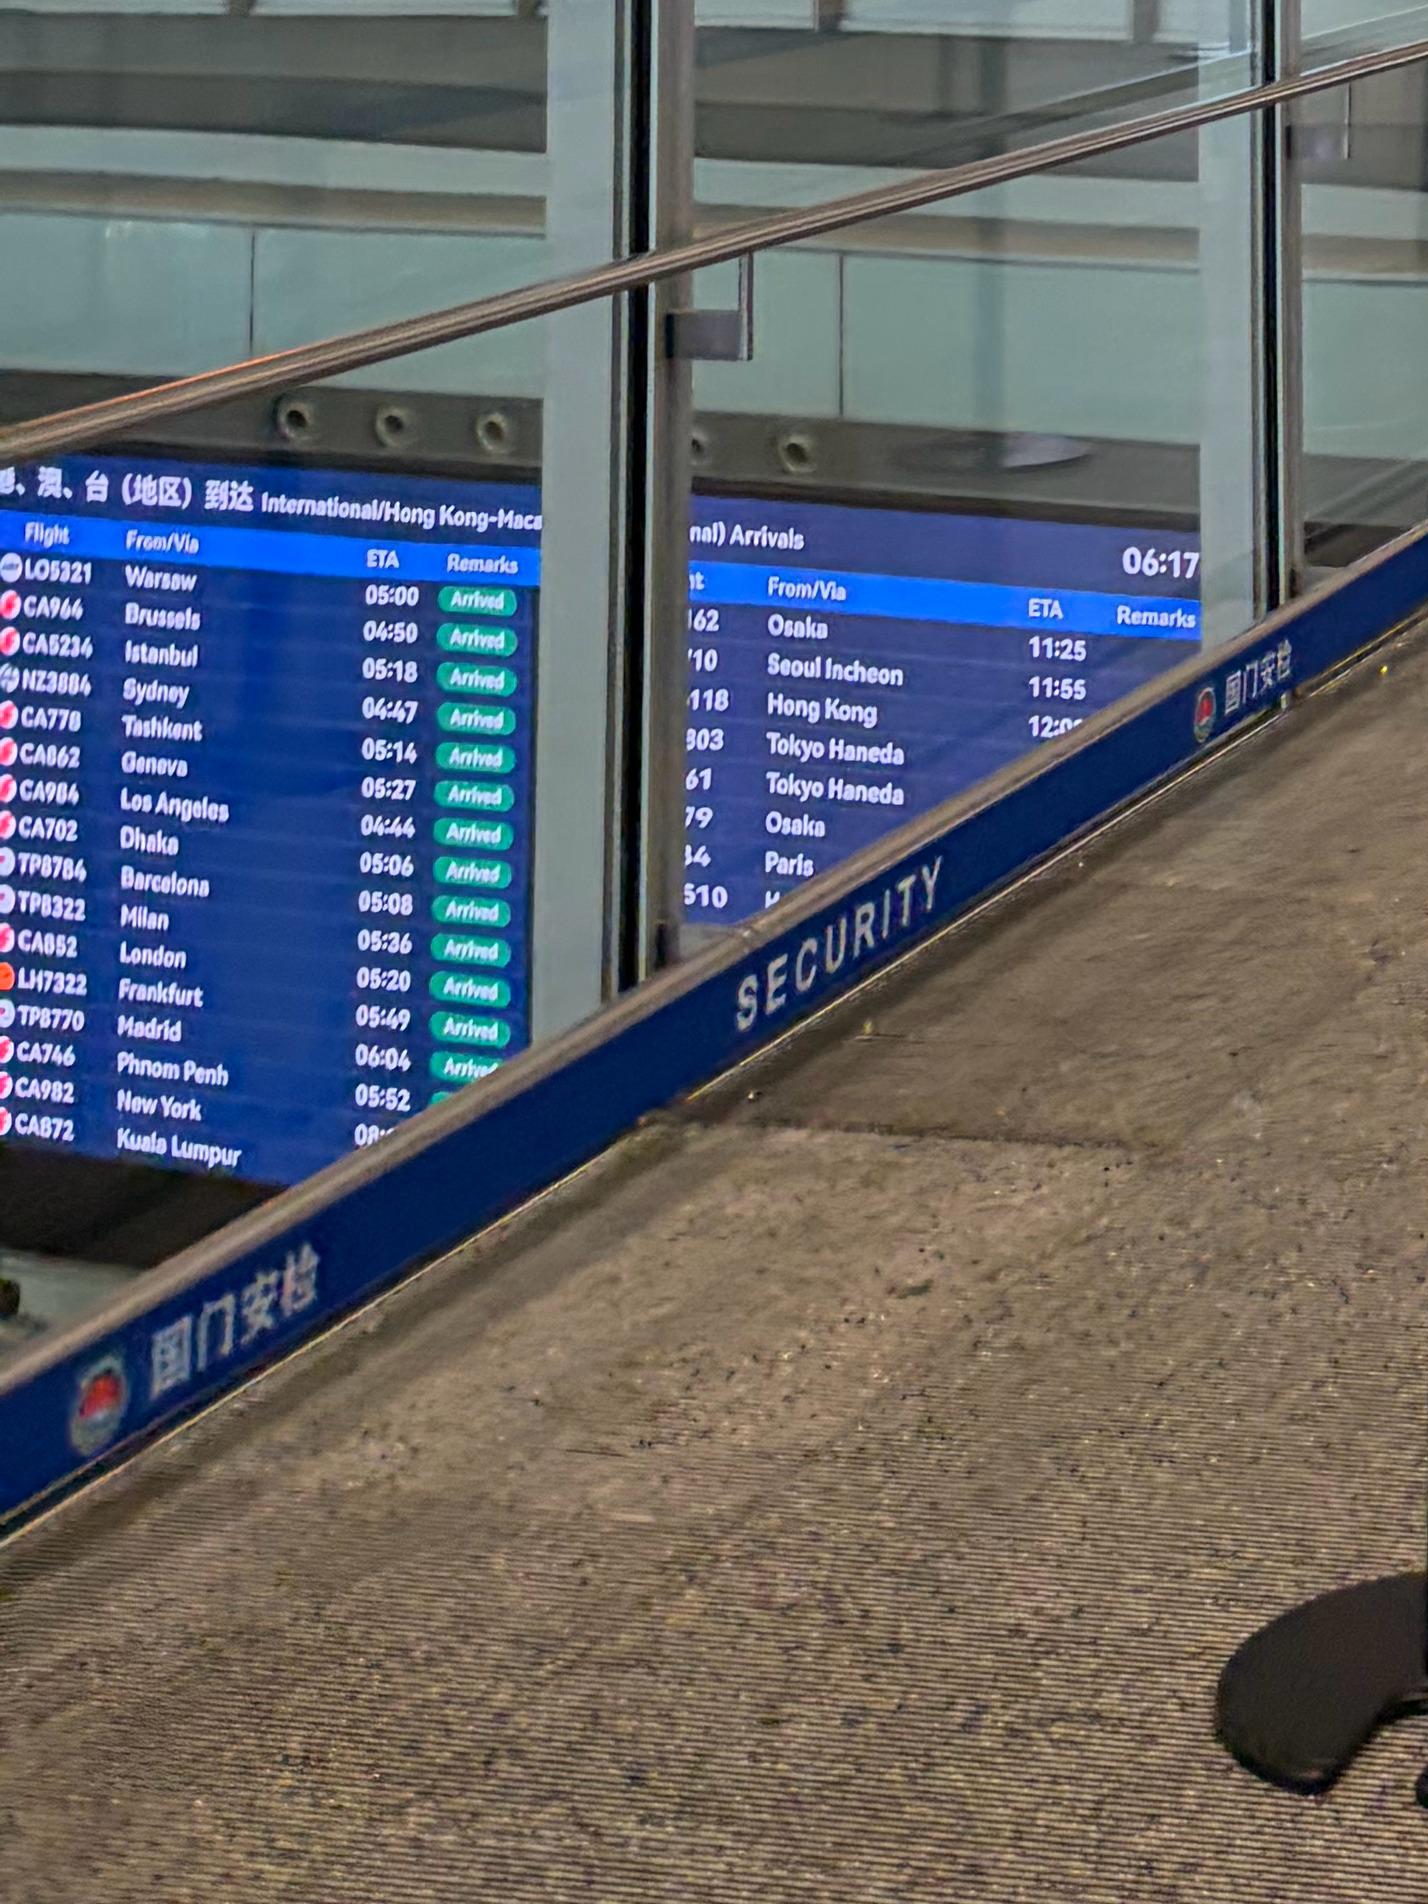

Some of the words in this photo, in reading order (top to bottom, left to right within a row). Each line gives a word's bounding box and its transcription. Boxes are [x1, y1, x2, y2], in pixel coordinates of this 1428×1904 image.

[25, 523, 70, 546] Flight
[127, 531, 198, 552] From/Via
[368, 550, 398, 567] ETA
[448, 554, 517, 573] Remarks
[730, 525, 804, 549] Arrivals
[126, 566, 196, 590] Warsaw
[366, 585, 418, 605] 05:00
[451, 591, 504, 610] Arrived
[1122, 548, 1199, 579] 06:17
[126, 603, 200, 629] Brussels
[364, 621, 417, 642] 04:50
[451, 628, 504, 650] Arrived
[767, 577, 847, 601] From/Via
[1028, 599, 1062, 620] ETA
[1117, 606, 1195, 628] Remarks
[769, 615, 827, 638] Osaka
[1029, 636, 1086, 661] 11:25
[126, 641, 197, 666] Istanbul
[363, 658, 417, 682] 05:18
[450, 669, 504, 689] Arrived
[769, 654, 820, 677] Seoul
[826, 658, 902, 685] Incheon
[1029, 676, 1086, 700] 11:55
[124, 679, 189, 707] Sydney
[363, 697, 417, 723] 04:47
[450, 708, 503, 730] Arrived
[769, 693, 819, 722] Hong
[826, 699, 876, 728] Kong
[122, 716, 201, 740] Tashkent
[362, 738, 416, 763] 05:14
[450, 746, 502, 769] Arrived
[767, 733, 824, 762] Tokyo
[830, 739, 903, 764] Haneda
[122, 752, 187, 776] Geneva
[362, 778, 415, 800] 05:27
[449, 784, 501, 806] Arrived
[767, 773, 823, 801] Tokyo
[829, 778, 903, 804] Haneda
[121, 789, 152, 811] Los
[156, 792, 228, 821] Angeles
[448, 822, 500, 844] Arrived
[766, 812, 824, 836] Osaka
[121, 826, 178, 855] Dhaka
[361, 852, 413, 876] 05:06
[446, 861, 500, 883] Arrived
[766, 852, 813, 876] Paris
[122, 866, 209, 896] Barcelona
[359, 891, 412, 915] 05:08
[446, 900, 499, 922] Arrived
[121, 905, 168, 929] Milan
[445, 939, 498, 961] Arrived
[736, 855, 943, 1031] SECURITY
[121, 942, 186, 967] London
[357, 967, 410, 991] 05:20
[444, 977, 498, 999] Arrived
[119, 979, 202, 1007] Frankfurt
[357, 1005, 410, 1030] 05:49
[444, 1017, 497, 1040] Arrived
[118, 1016, 181, 1041] Madrid
[356, 1044, 410, 1070] 06:04
[118, 1052, 179, 1079] Phnom
[184, 1061, 228, 1085] Penh
[356, 1084, 410, 1111] 05:52
[118, 1090, 157, 1114] New
[161, 1096, 201, 1120] York
[118, 1128, 166, 1154] Kuala
[172, 1136, 241, 1168] Lumpur
